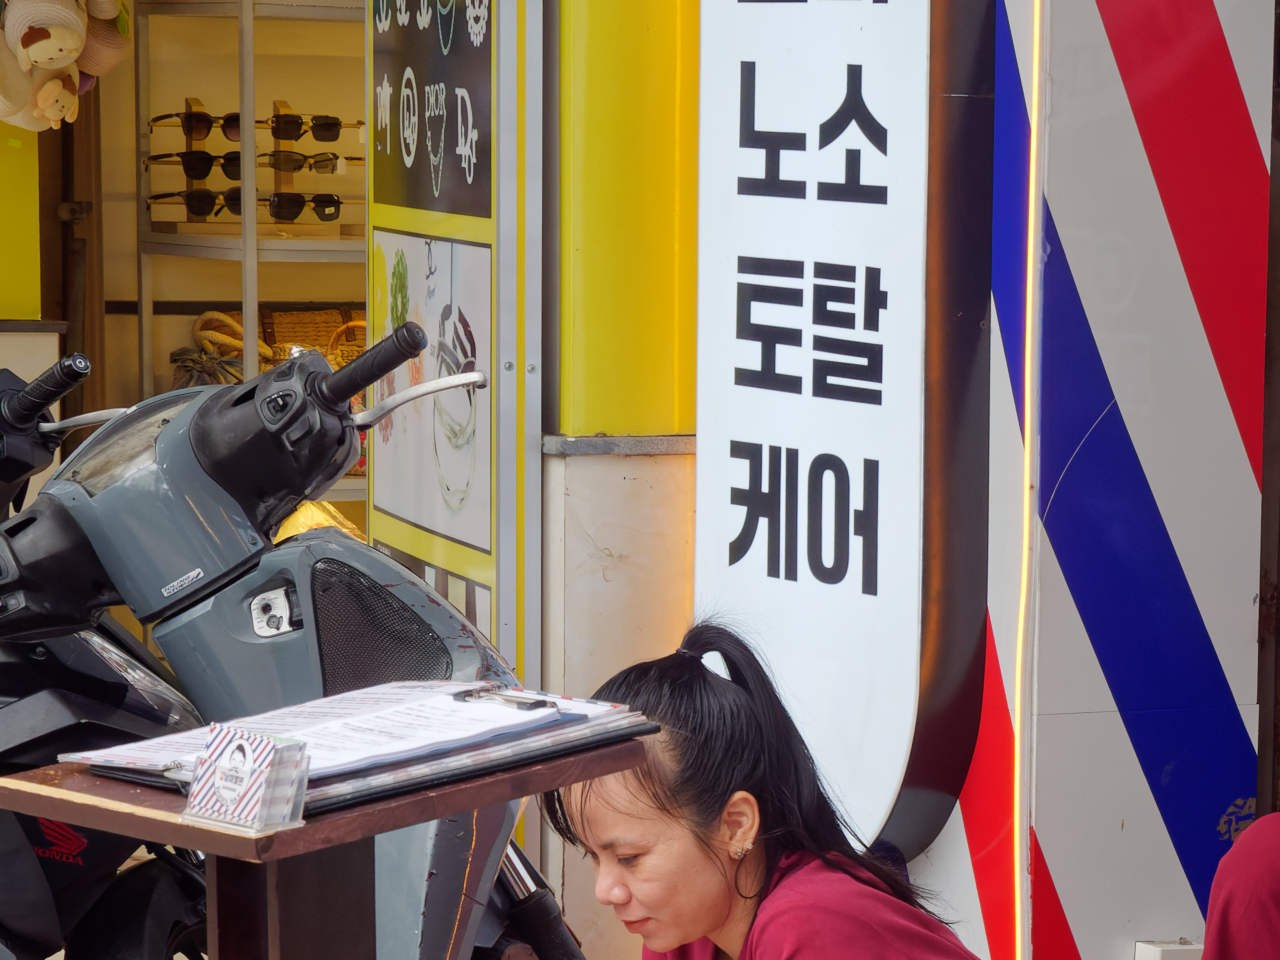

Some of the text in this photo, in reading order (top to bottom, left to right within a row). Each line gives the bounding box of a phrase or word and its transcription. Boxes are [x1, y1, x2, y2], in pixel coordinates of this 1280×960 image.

[424, 82, 447, 117] DIOR
[736, 61, 889, 205] 노소
[734, 255, 889, 406] 토탈
[728, 440, 880, 596] 케어
